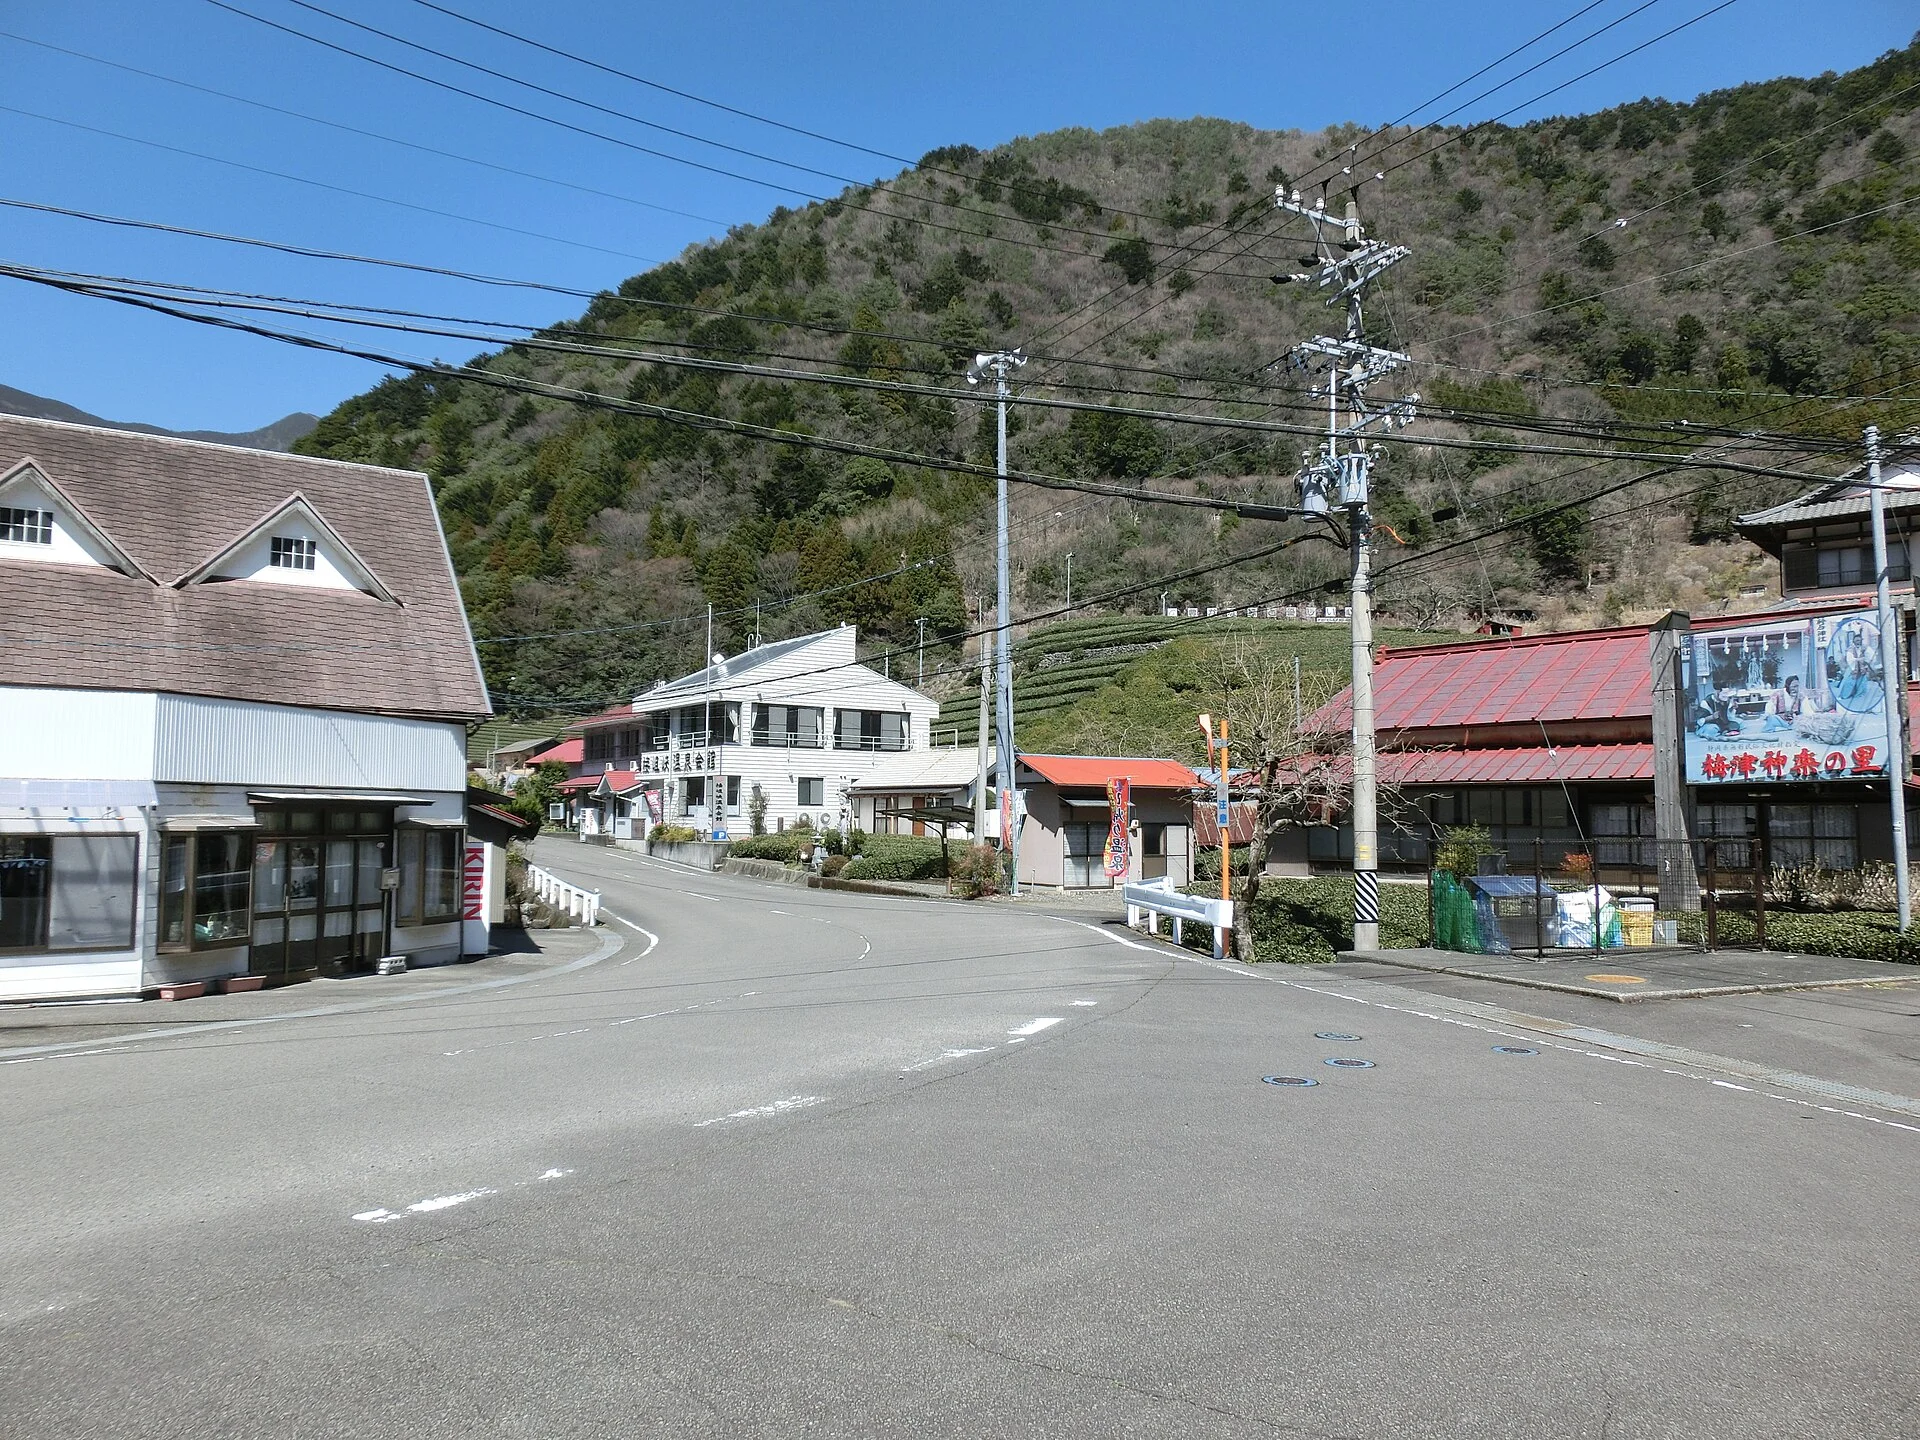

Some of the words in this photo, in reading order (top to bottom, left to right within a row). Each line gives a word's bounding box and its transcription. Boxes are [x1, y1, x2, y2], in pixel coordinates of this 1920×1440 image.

[1702, 745, 1882, 780] 梅津神楽の里
[464, 847, 485, 921] KIRIN
